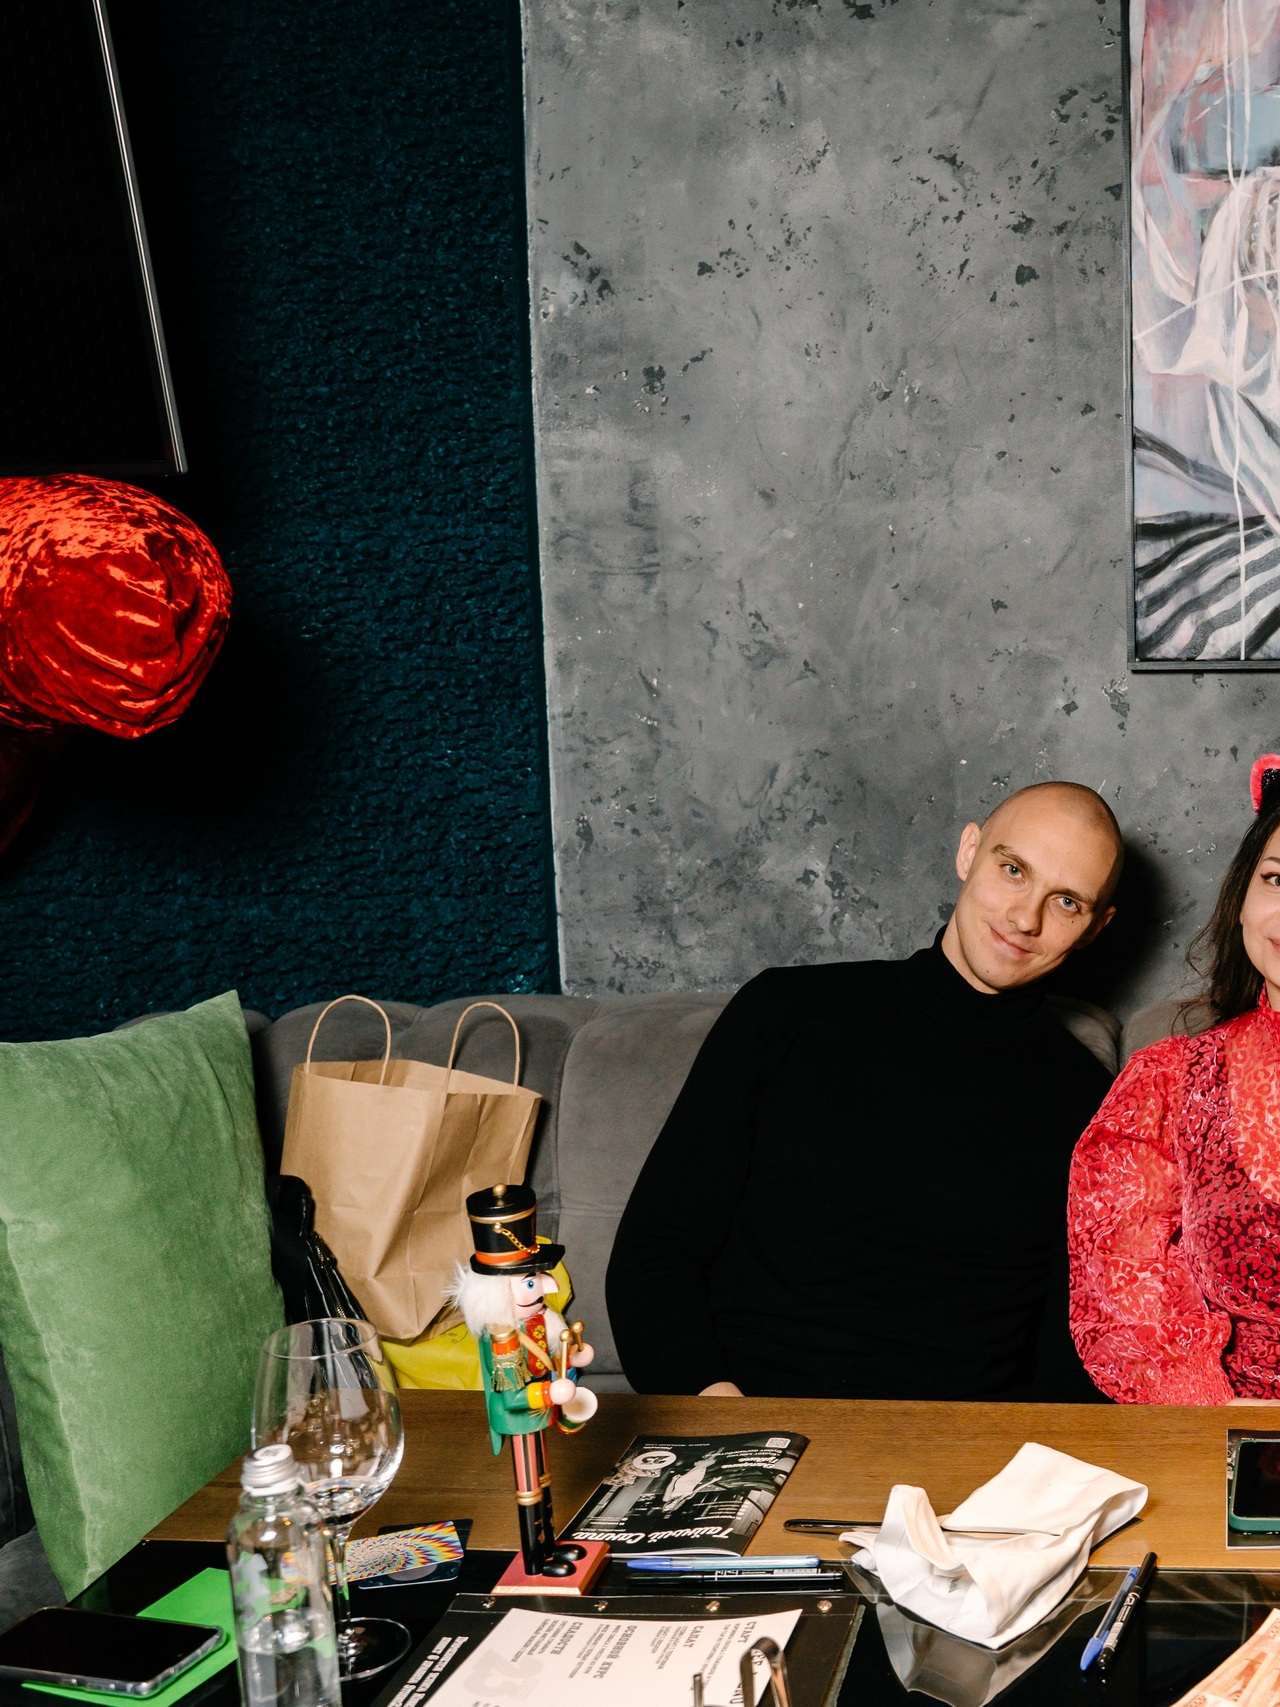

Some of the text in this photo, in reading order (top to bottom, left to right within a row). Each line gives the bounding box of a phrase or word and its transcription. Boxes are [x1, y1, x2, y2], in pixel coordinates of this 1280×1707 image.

[572, 1526, 734, 1544] Тайный Санта
[550, 1622, 583, 1655] СЛАДОСТИ
[606, 1625, 637, 1660] ОСНОВНОЙ
[683, 1625, 704, 1648] САЛАТ
[737, 1621, 757, 1644] СТАРТ
[593, 1658, 614, 1679] КУРС
